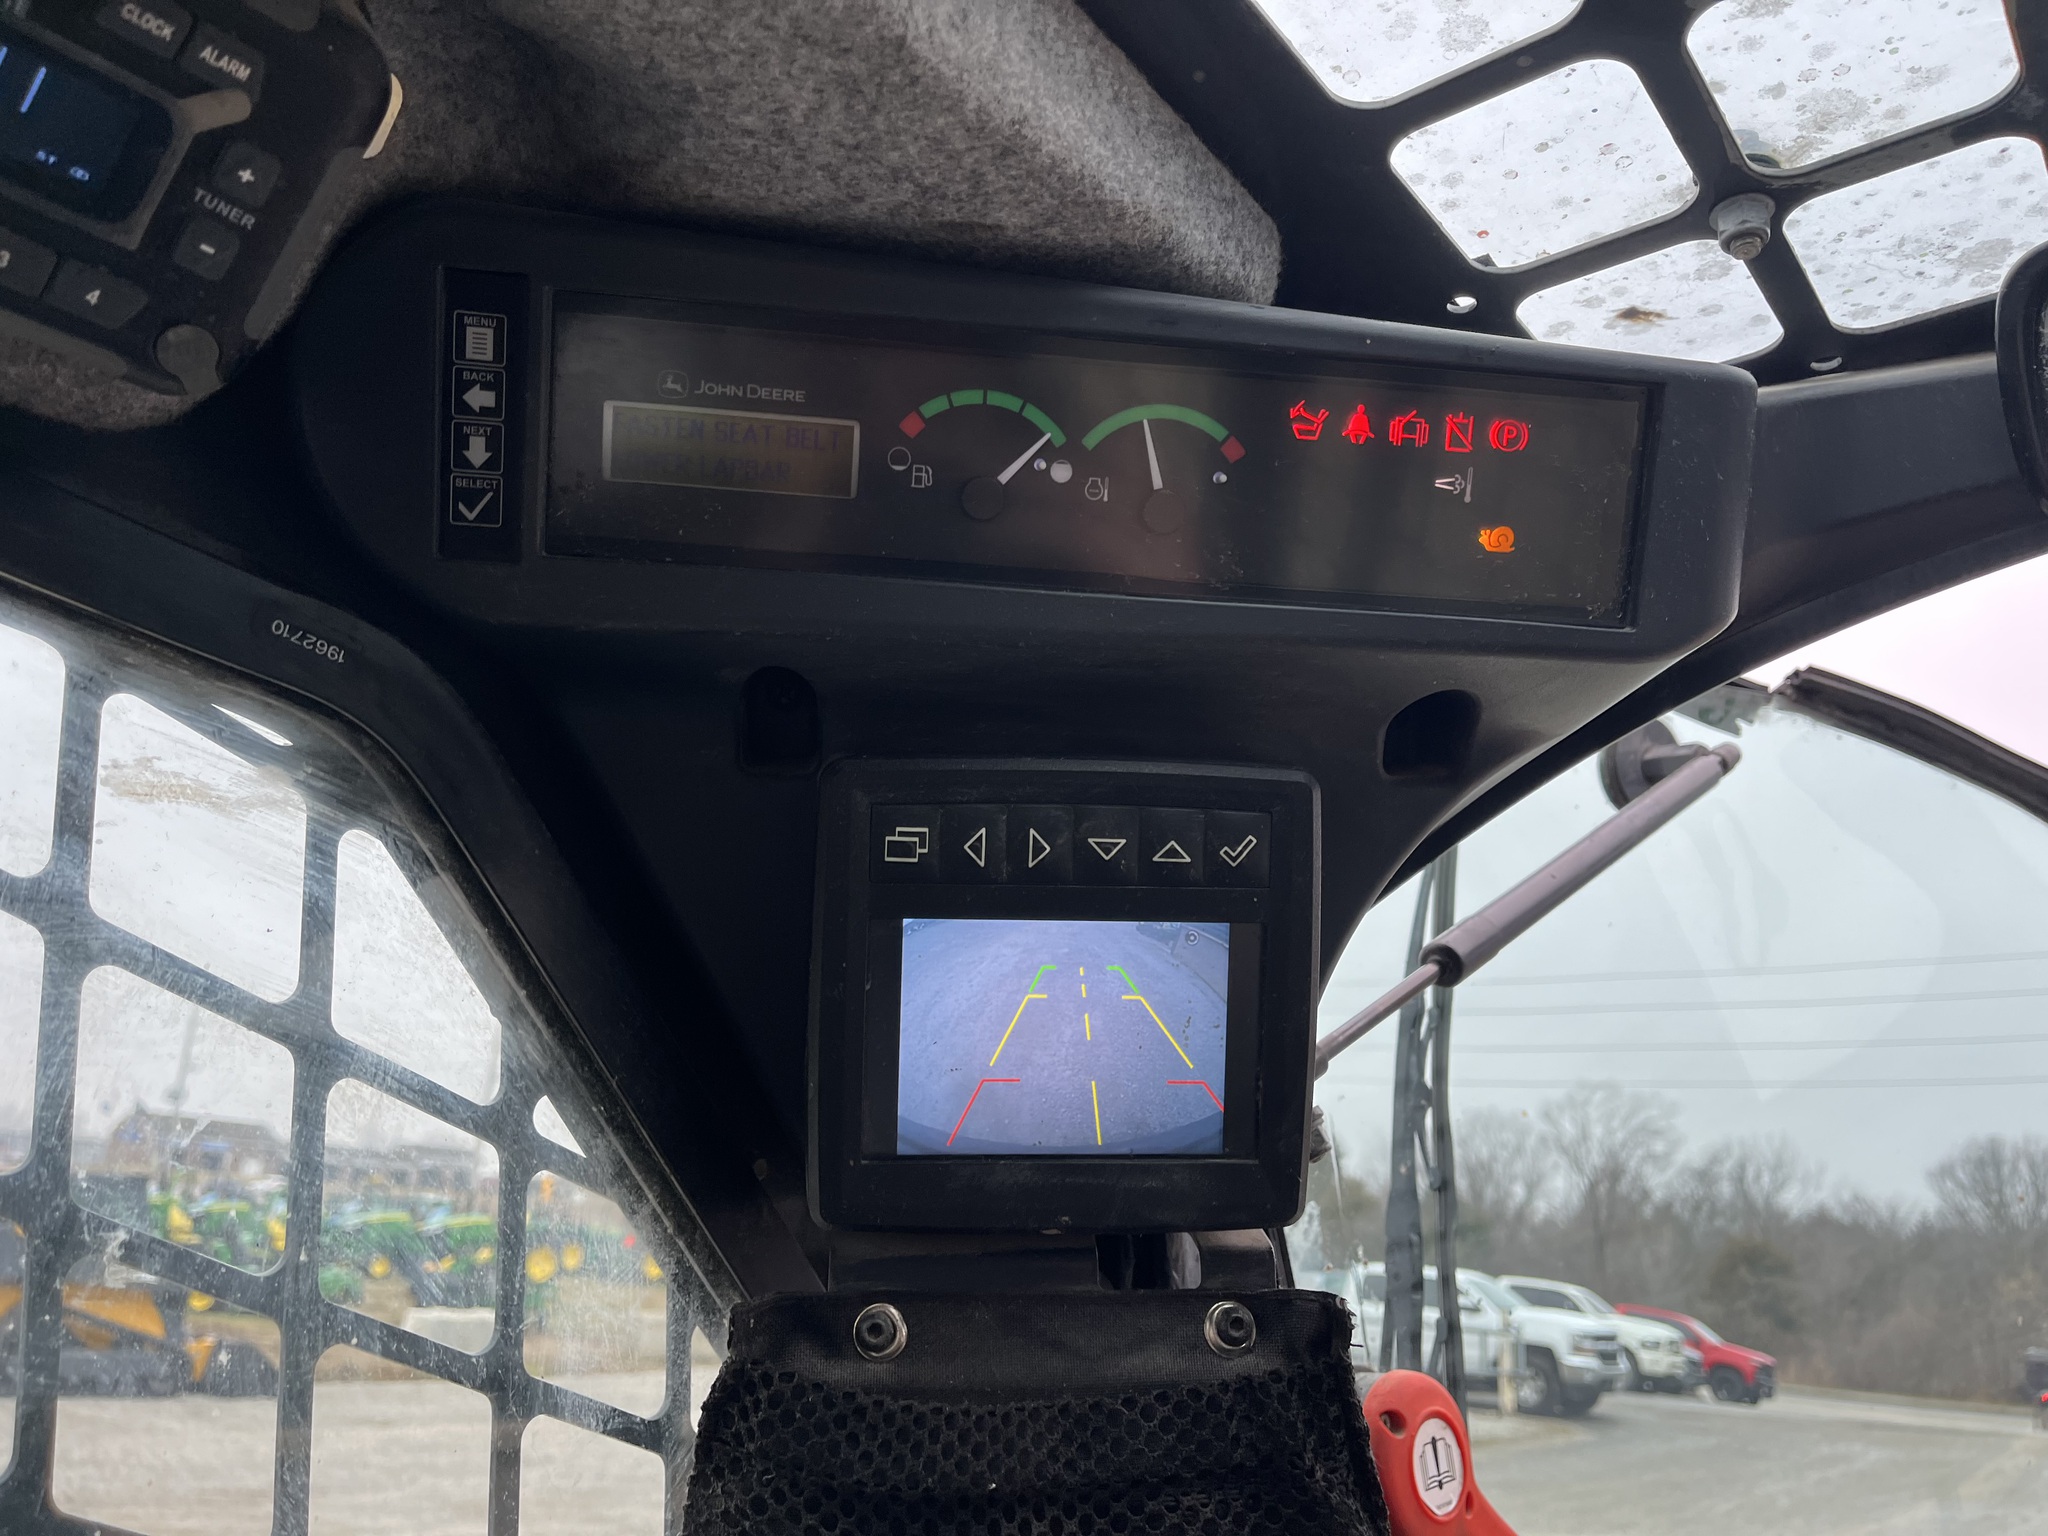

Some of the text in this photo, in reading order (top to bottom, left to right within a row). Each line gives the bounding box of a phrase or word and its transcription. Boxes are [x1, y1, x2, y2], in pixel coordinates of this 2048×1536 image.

[120, 3, 175, 41] CLOCK
[199, 45, 252, 82] ALARM
[193, 187, 256, 231] TUNER
[85, 289, 101, 307] 4
[463, 315, 497, 328] MENU
[462, 370, 495, 383] BACK
[694, 383, 806, 403] JOHN DEERE
[462, 425, 492, 437] NEXT
[714, 420, 773, 447] SEAT
[786, 426, 844, 453] BELT
[455, 477, 498, 490] SELECT
[272, 619, 345, 663] 1962710
